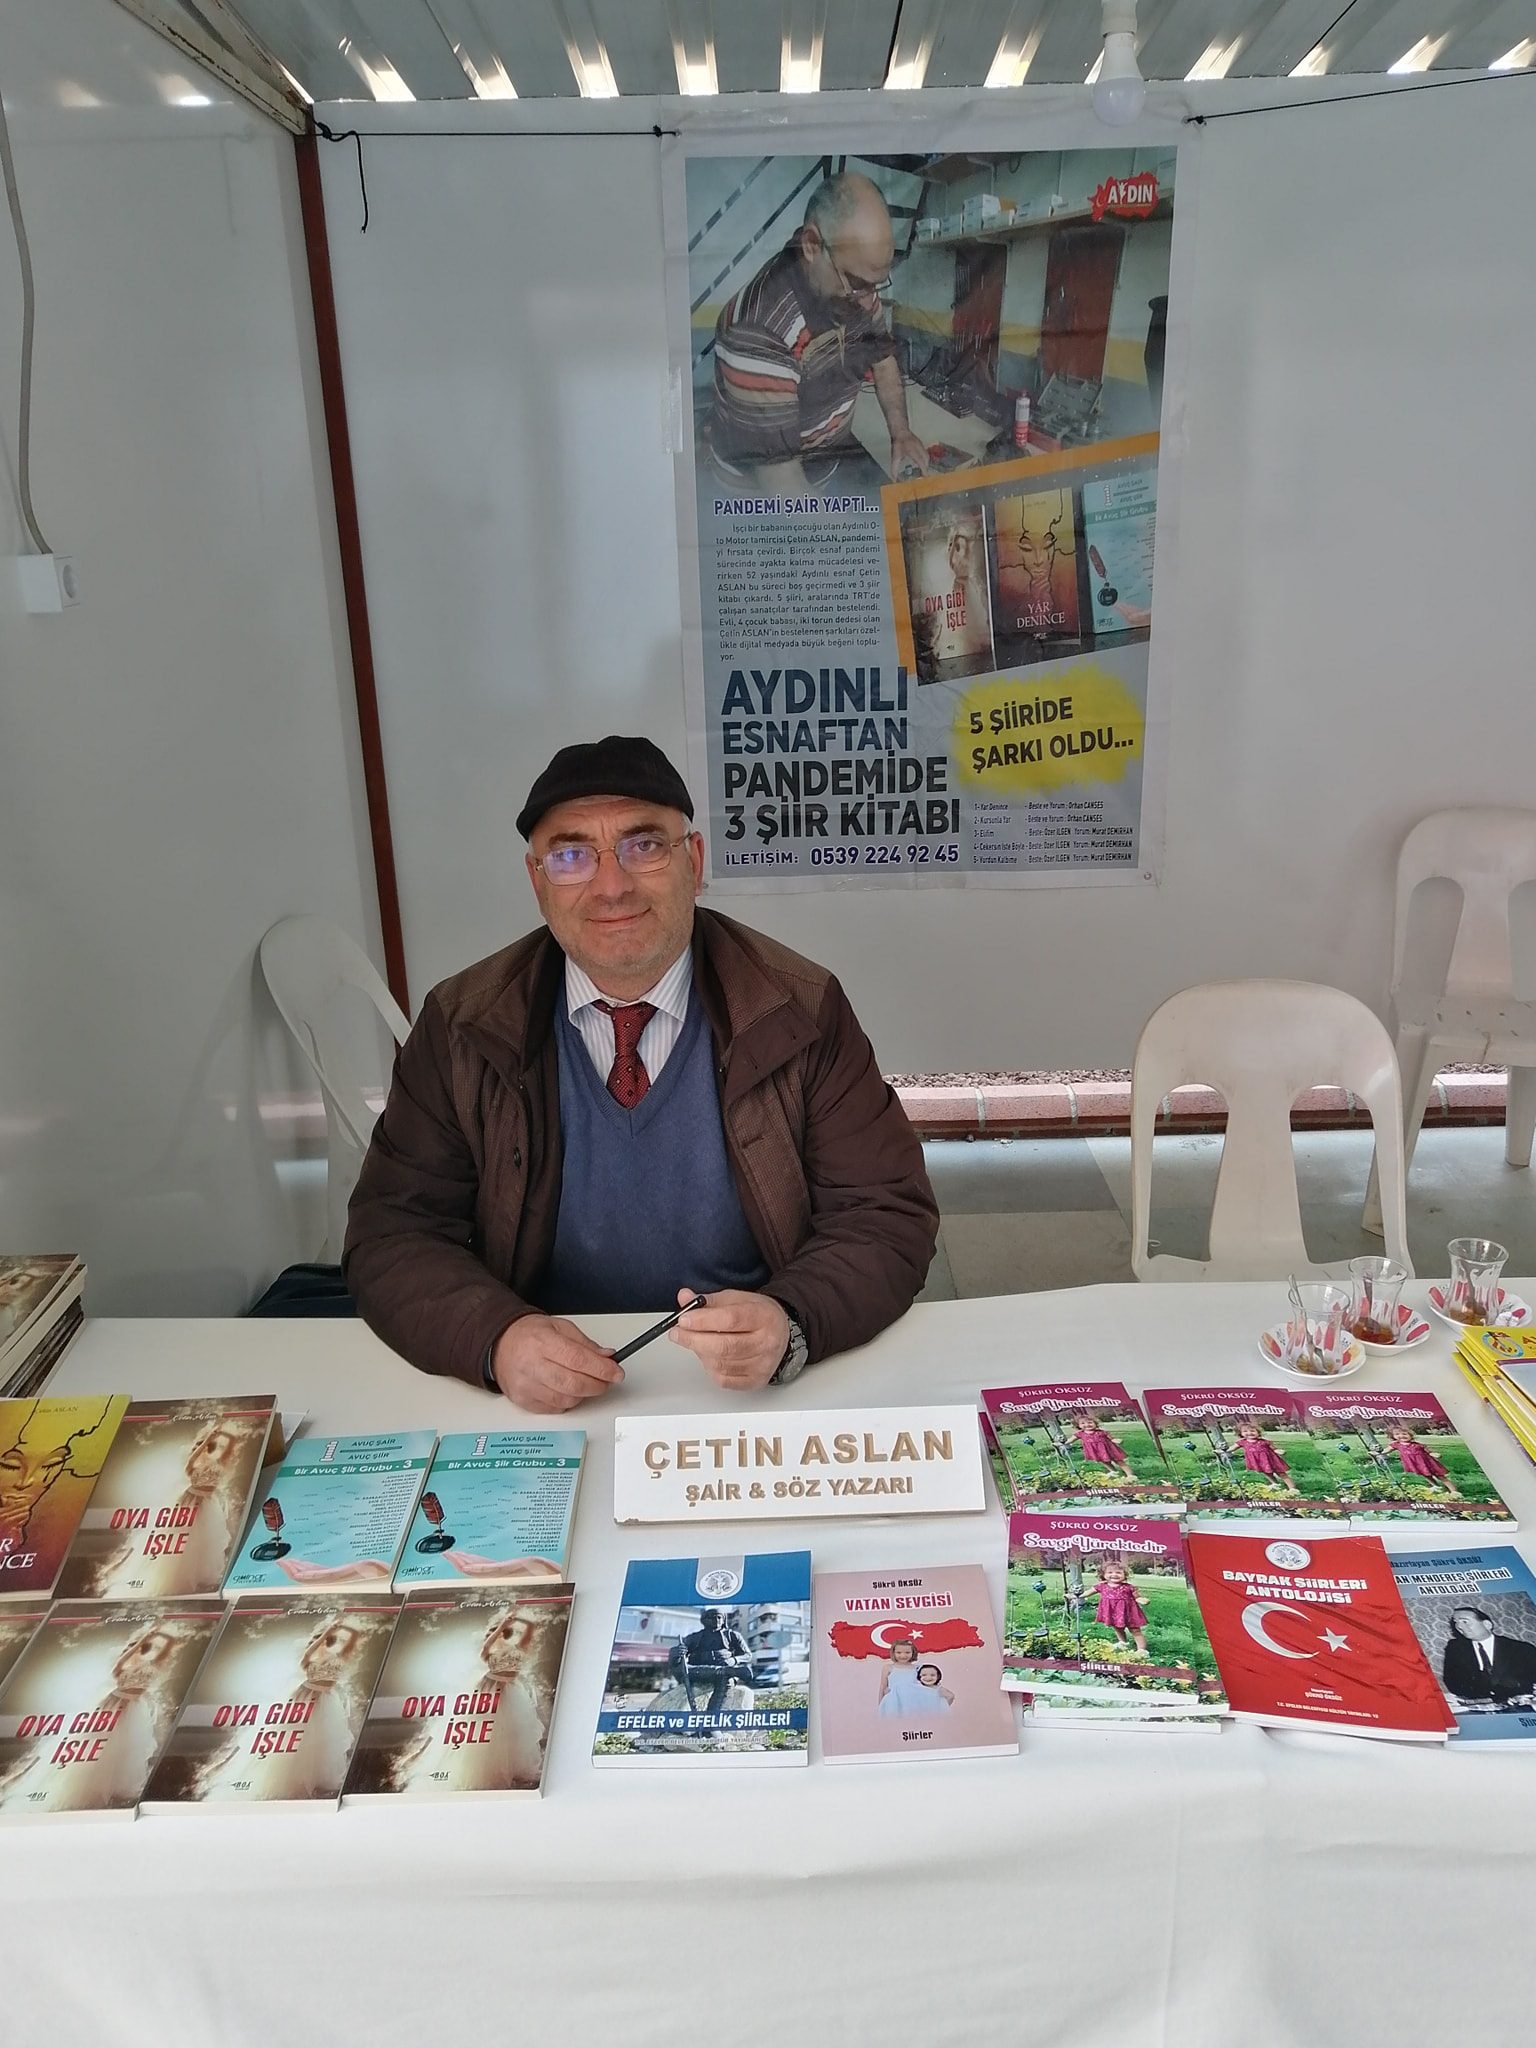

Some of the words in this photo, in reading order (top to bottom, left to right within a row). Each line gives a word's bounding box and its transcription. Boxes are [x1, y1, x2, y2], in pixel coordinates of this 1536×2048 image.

[714, 495, 780, 515] PANDEMİ
[785, 495, 819, 518] ŞAİR
[823, 497, 879, 513] YAPTI...
[751, 536, 785, 544] tamircisi
[787, 536, 808, 545] Çetin
[717, 560, 756, 568] sürecinde
[760, 560, 786, 568] ayakta
[818, 558, 864, 566] mücadelesi
[925, 595, 944, 614] OYA
[946, 589, 966, 610] GİBİ
[946, 610, 966, 632] İŞLE
[721, 667, 907, 715] AYDINLI
[971, 712, 983, 733] 5
[990, 697, 1073, 735] ŞİİRİDE
[723, 717, 907, 754] ESNAFTAN
[973, 739, 1042, 773] ŞARKI
[1050, 727, 1133, 758] OLDU...
[724, 750, 947, 798] PANDEMİDE
[725, 806, 745, 840] 3
[757, 796, 828, 845] ŞİİR
[841, 794, 959, 835] KİTABI
[726, 851, 798, 866] İLETİŞİM:
[811, 847, 859, 865] 0539
[865, 846, 901, 865] 224
[907, 846, 929, 863] 92
[935, 845, 959, 862] 45
[1000, 1401, 1042, 1414] Sevgi
[1040, 1398, 1121, 1413] Yürektedir
[1161, 1404, 1205, 1418] Sevgi
[1202, 1403, 1286, 1418] Yürektedir
[1309, 1406, 1352, 1420] Sevgi
[1350, 1405, 1434, 1420] Yürektedir
[375, 1438, 396, 1447] ŞAİR
[501, 1435, 524, 1443] AVUÇ
[525, 1435, 546, 1443] ŞAİR
[500, 1448, 523, 1456] AVUÇ
[644, 1430, 782, 1478] ÇETİN
[800, 1430, 953, 1465] ASLAN
[294, 1467, 309, 1476] Bir
[311, 1466, 338, 1475] Avuç
[359, 1464, 393, 1472] Grubu
[403, 1460, 412, 1469] 3
[463, 1461, 491, 1469] Avuç
[512, 1459, 546, 1467] Grubu
[557, 1458, 566, 1467] 3
[686, 1479, 740, 1507] ŞAİR
[749, 1482, 765, 1499] &
[774, 1476, 821, 1498] SÖZ
[828, 1477, 912, 1496] YAZARI
[110, 1508, 150, 1530] OYA
[155, 1503, 200, 1528] GİBİ
[142, 1530, 189, 1560] İŞLE
[1023, 1533, 1072, 1551] Sevgi
[1069, 1534, 1167, 1554] Yürektedir
[872, 1581, 896, 1589] Şükrü
[1223, 1570, 1293, 1587] BAYRAK
[1411, 1573, 1464, 1583] MENDERES
[1245, 1585, 1352, 1604] ANTOLOJİSİ
[1419, 1583, 1480, 1595] ANTOLOJİSİ
[845, 1597, 891, 1611] VATAN
[896, 1592, 952, 1609] SEVGİSİ
[212, 1704, 260, 1728] OYA
[265, 1698, 315, 1725] GİBİ
[401, 1695, 446, 1719] OYA
[453, 1689, 501, 1716] GİBİ
[15, 1714, 65, 1739] OYA
[68, 1707, 124, 1735] GİBİ
[618, 1715, 665, 1729] EFELER
[669, 1717, 684, 1728] ve
[688, 1712, 732, 1728] EFELİK
[735, 1711, 791, 1729] ŞİİRLERİ
[250, 1727, 305, 1760] İŞLE
[443, 1718, 494, 1749] İŞLE
[902, 1731, 933, 1741] Şiirler
[50, 1736, 108, 1769] İŞLE
